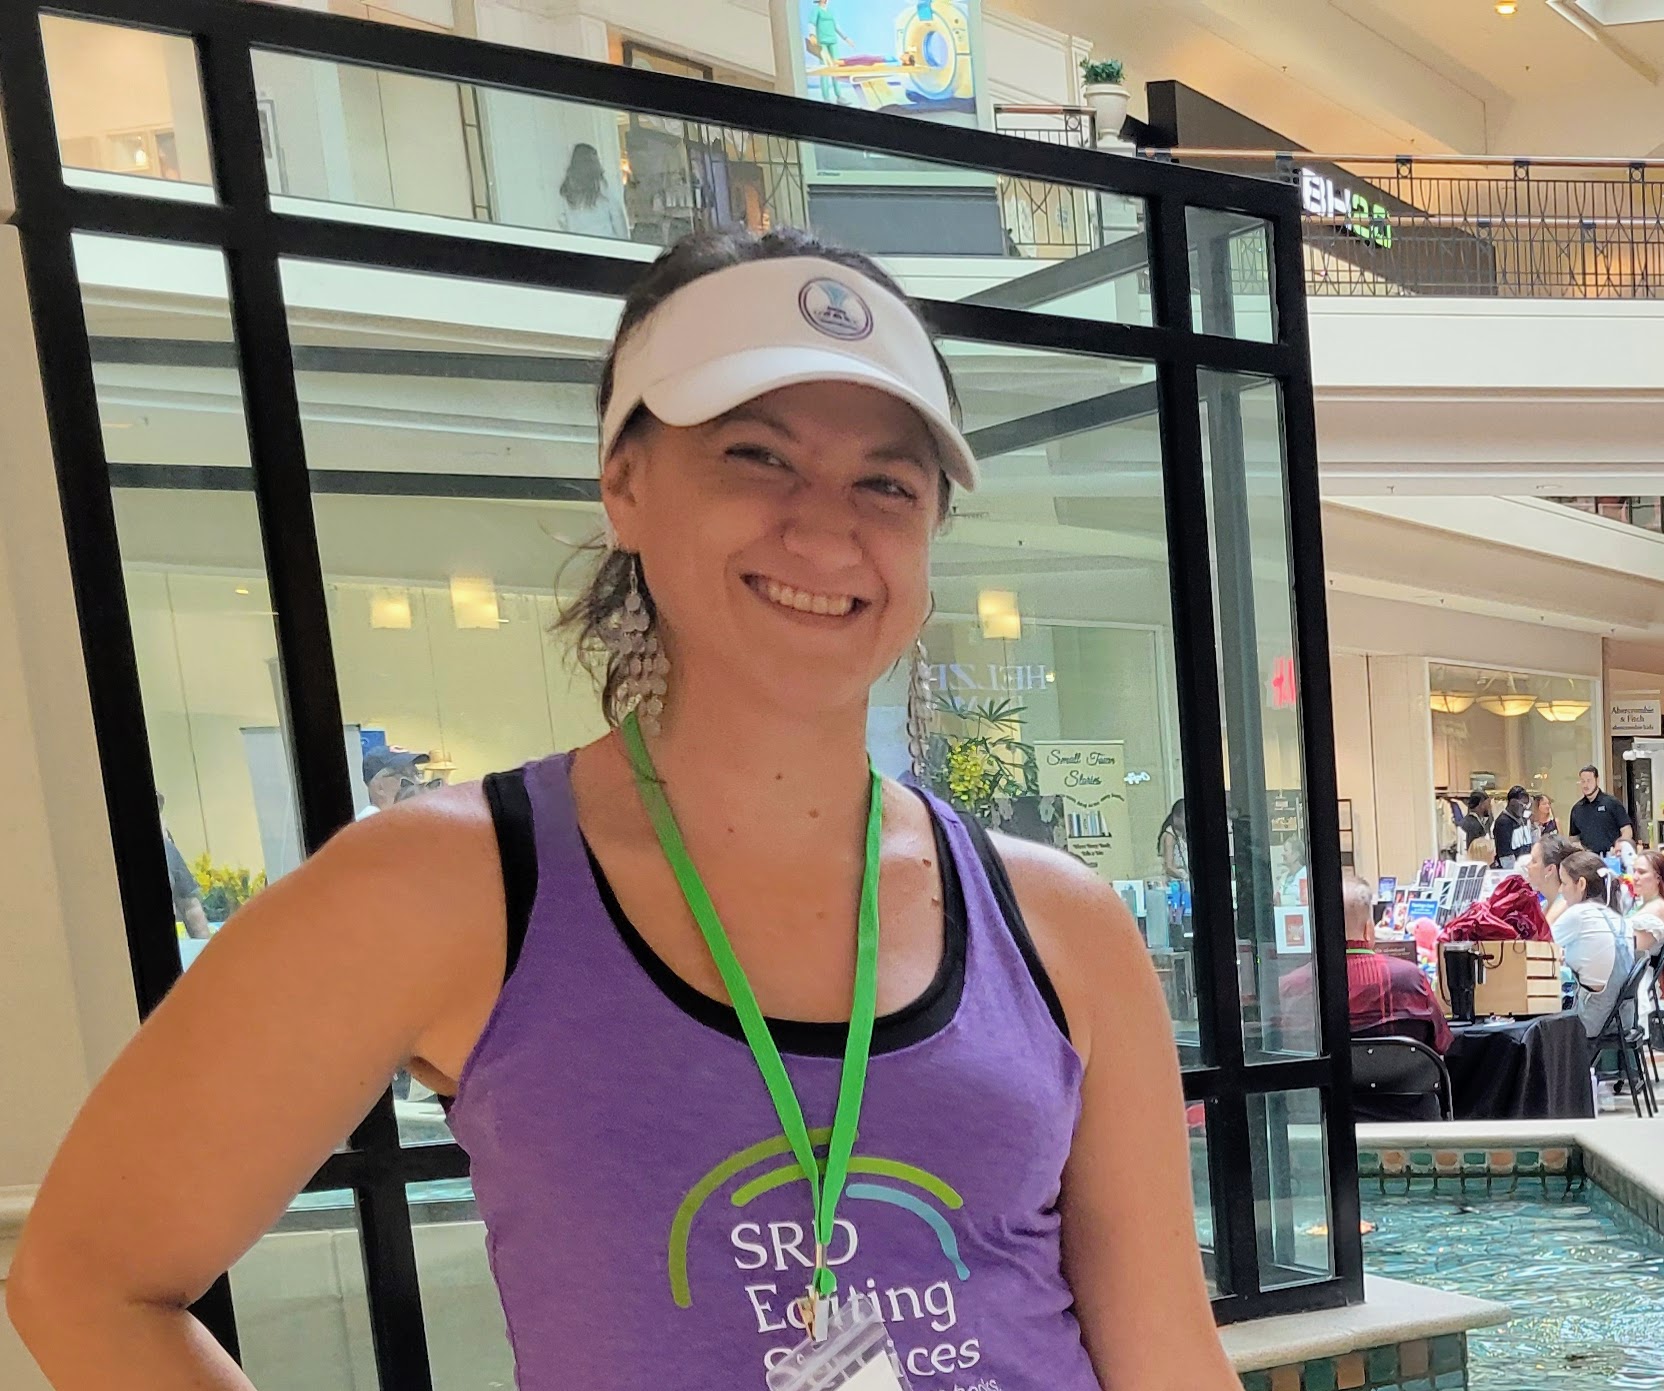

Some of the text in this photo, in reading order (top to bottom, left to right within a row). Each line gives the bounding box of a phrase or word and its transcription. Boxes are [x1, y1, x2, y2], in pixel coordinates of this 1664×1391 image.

[1047, 749, 1081, 766] Small
[1064, 769, 1102, 788] Stories
[730, 1219, 858, 1271] SRD
